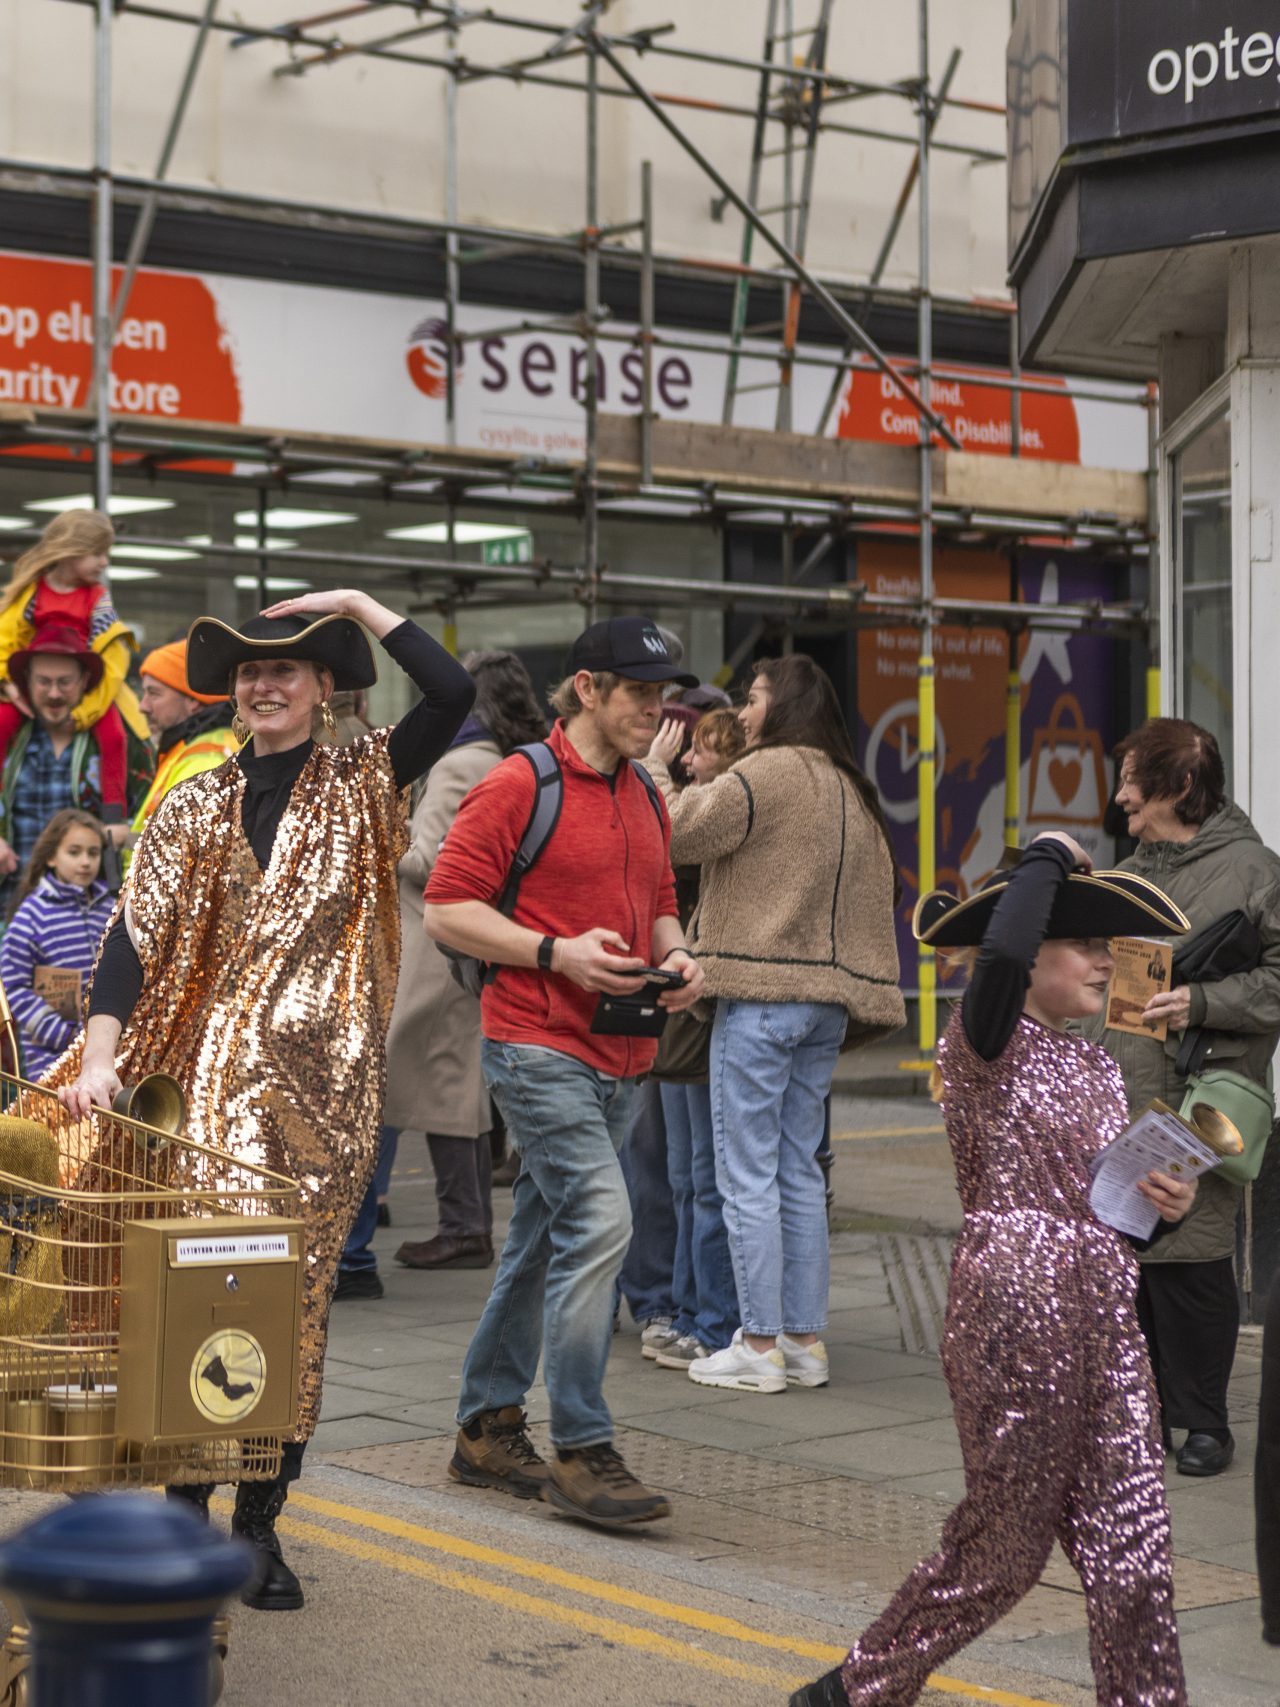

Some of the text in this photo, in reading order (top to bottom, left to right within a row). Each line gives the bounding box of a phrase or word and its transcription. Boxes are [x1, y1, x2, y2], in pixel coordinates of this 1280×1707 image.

[1147, 27, 1280, 104] opte
[47, 303, 167, 351] eluen
[104, 374, 181, 414] tore
[954, 417, 1044, 449] Disabiliies.
